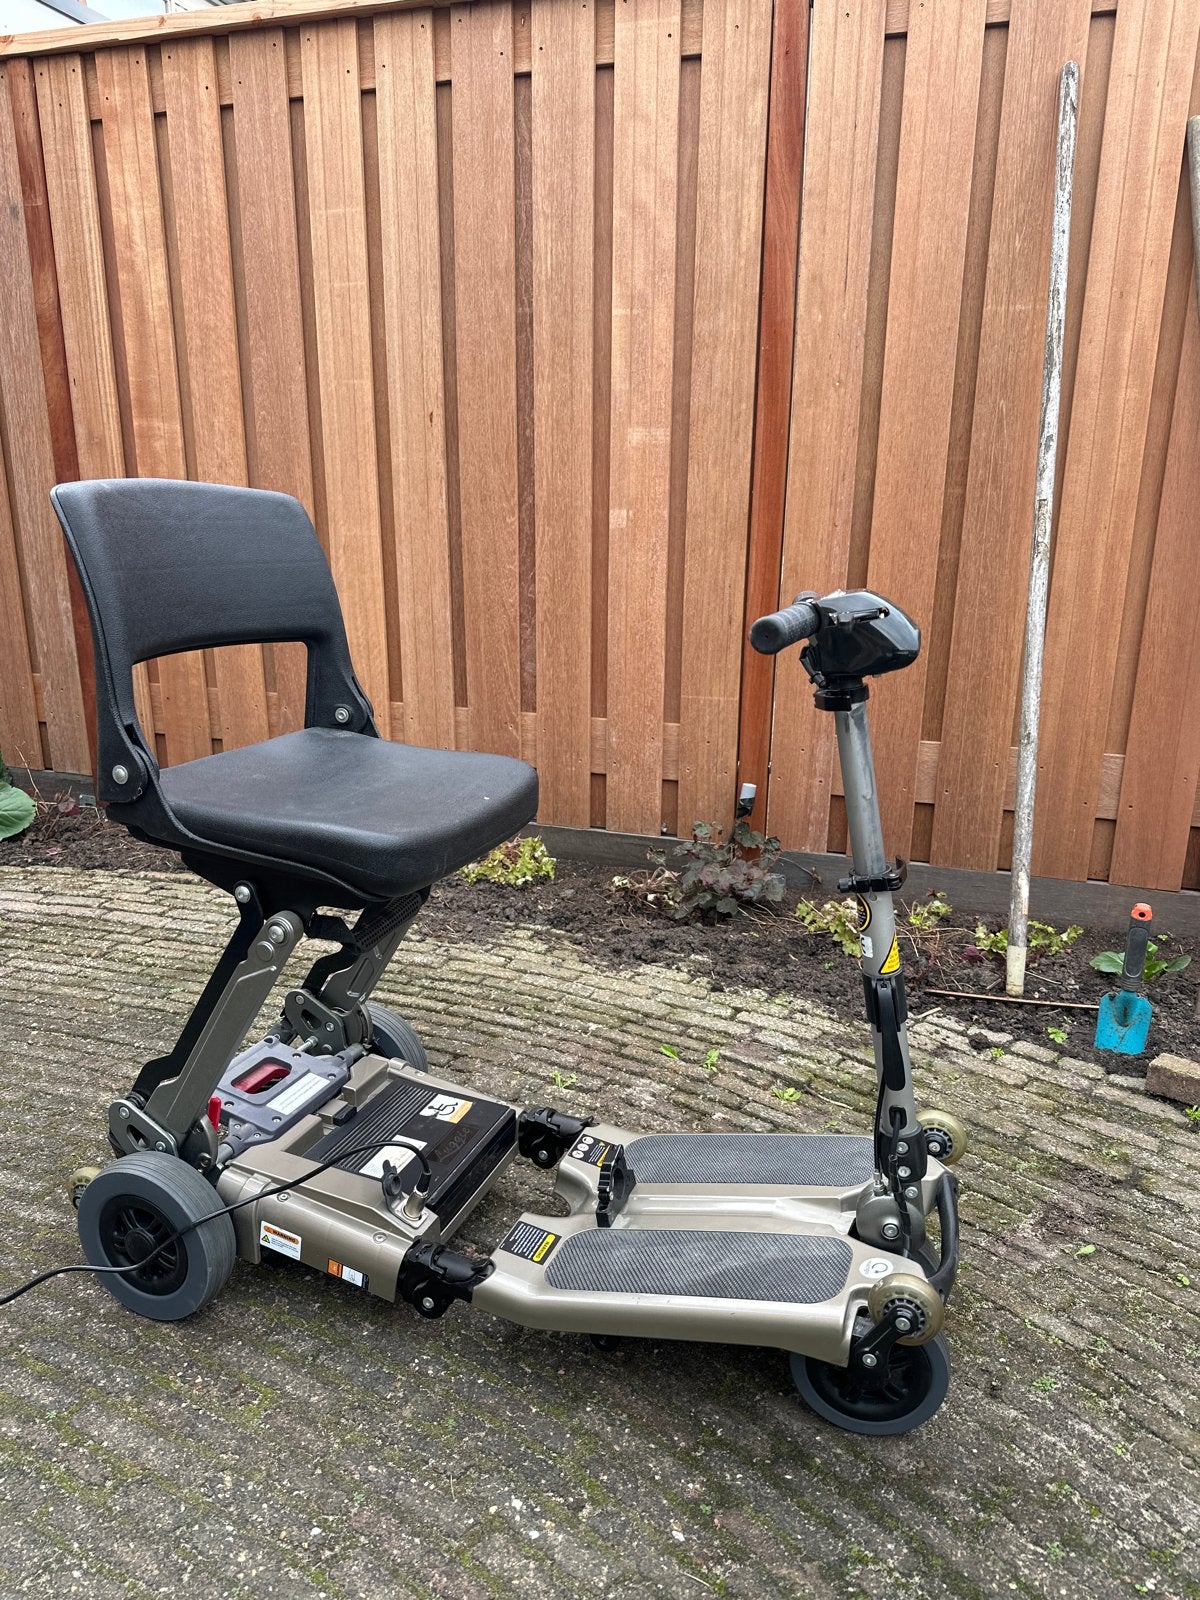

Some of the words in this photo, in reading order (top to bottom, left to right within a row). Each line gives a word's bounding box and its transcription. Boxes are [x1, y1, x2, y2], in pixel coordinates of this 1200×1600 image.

[434, 1127, 470, 1162] Luggie
[271, 1227, 296, 1243] WARNING
[535, 1241, 550, 1259] WARNING
